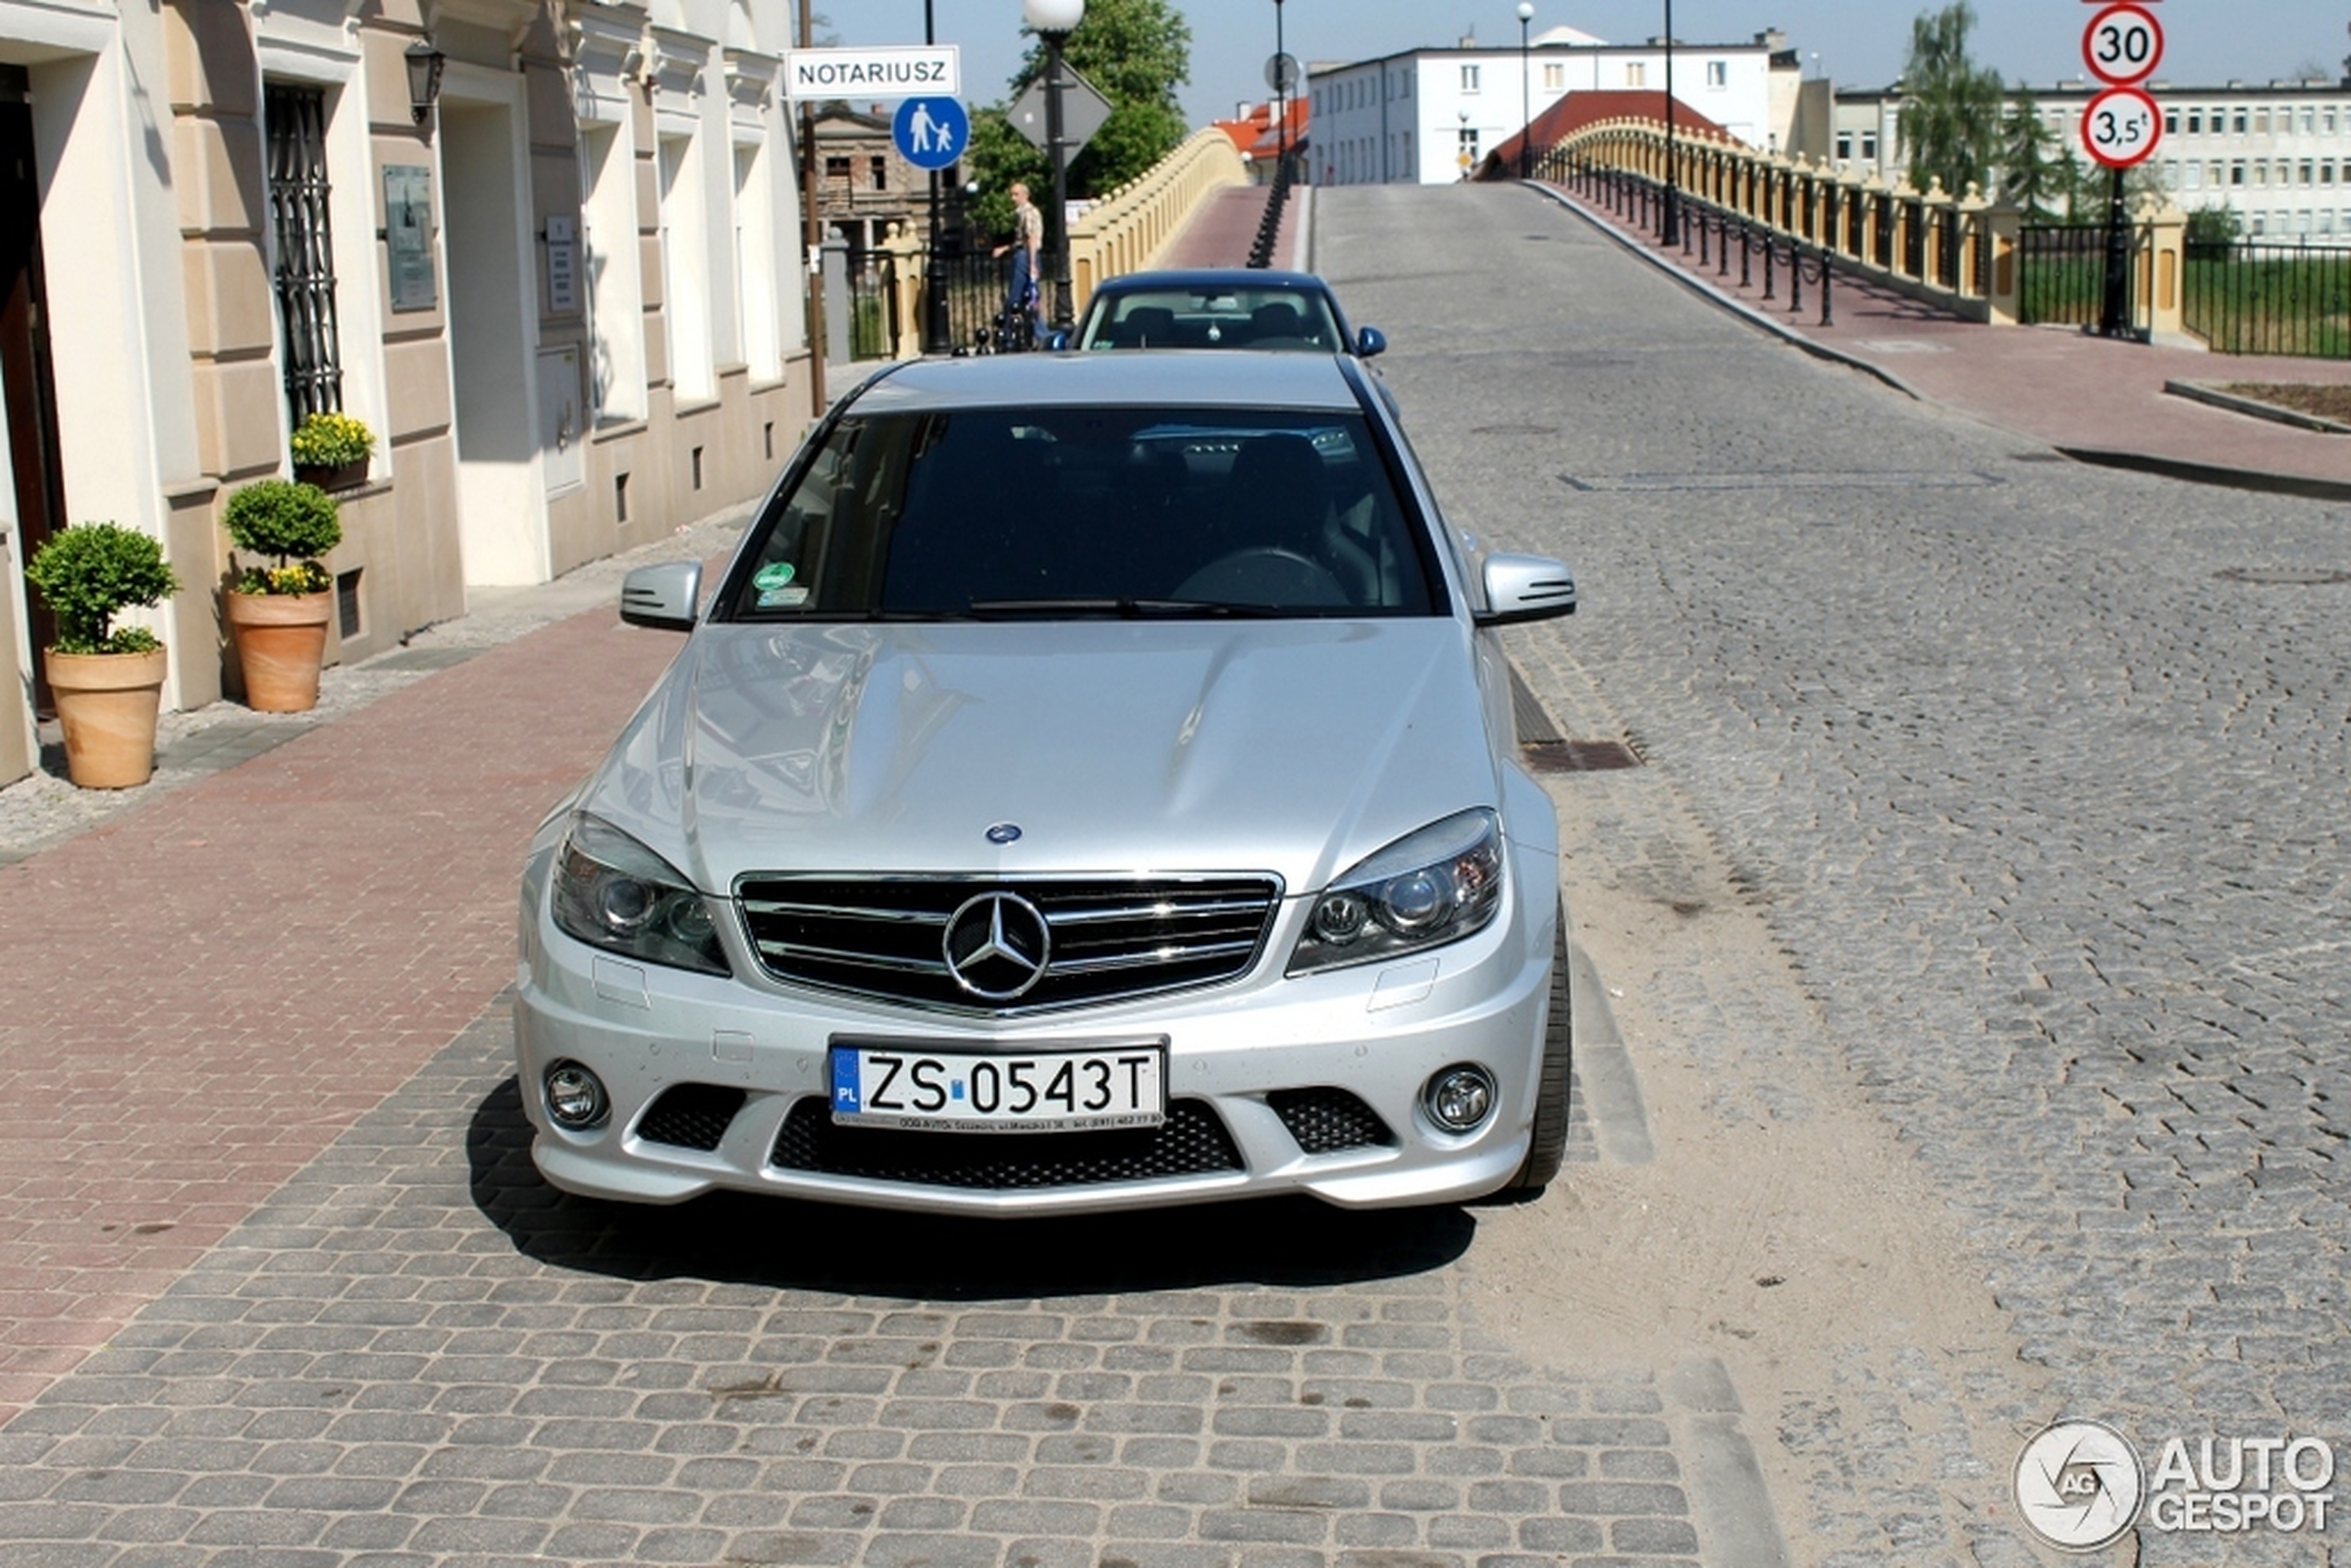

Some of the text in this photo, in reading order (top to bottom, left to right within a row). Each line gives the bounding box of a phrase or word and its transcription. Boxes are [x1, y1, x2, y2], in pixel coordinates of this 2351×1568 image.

[2097, 25, 2148, 63] 30
[799, 61, 946, 84] NOTARIUSZ
[839, 1088, 857, 1102] PL
[869, 1057, 1150, 1113] ZS 0543T
